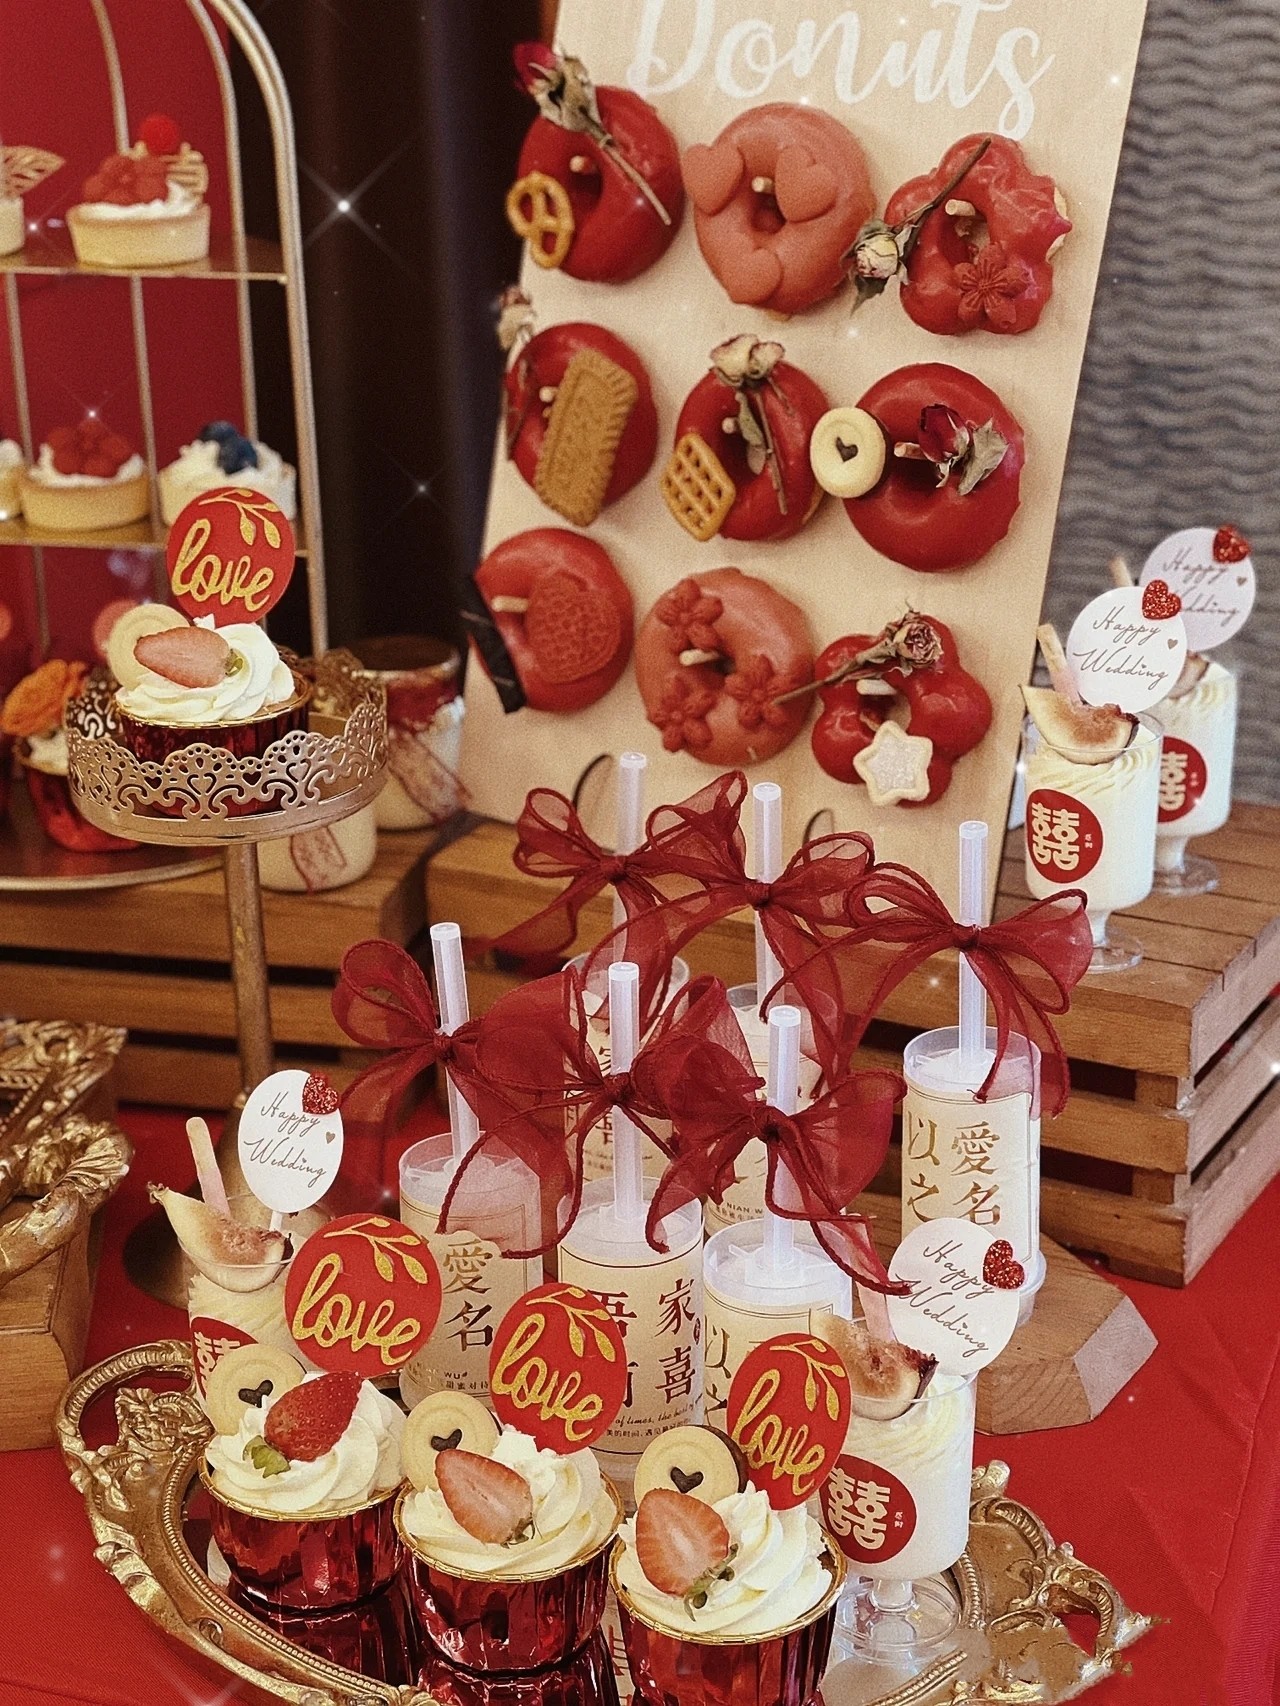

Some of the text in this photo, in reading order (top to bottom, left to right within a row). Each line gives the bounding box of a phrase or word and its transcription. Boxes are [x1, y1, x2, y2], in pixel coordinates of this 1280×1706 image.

[627, 0, 1056, 141] Donuts
[171, 518, 275, 612] love
[1163, 547, 1230, 585] Happy
[1092, 605, 1161, 646] Happy
[1073, 646, 1169, 691] Wedding
[261, 1090, 321, 1138] Happy
[243, 1136, 327, 1189] Wedding
[923, 1239, 995, 1301] Happy
[291, 1252, 421, 1366] love
[895, 1273, 989, 1358] Wedding
[491, 1312, 604, 1442] love
[731, 1368, 826, 1497] love
